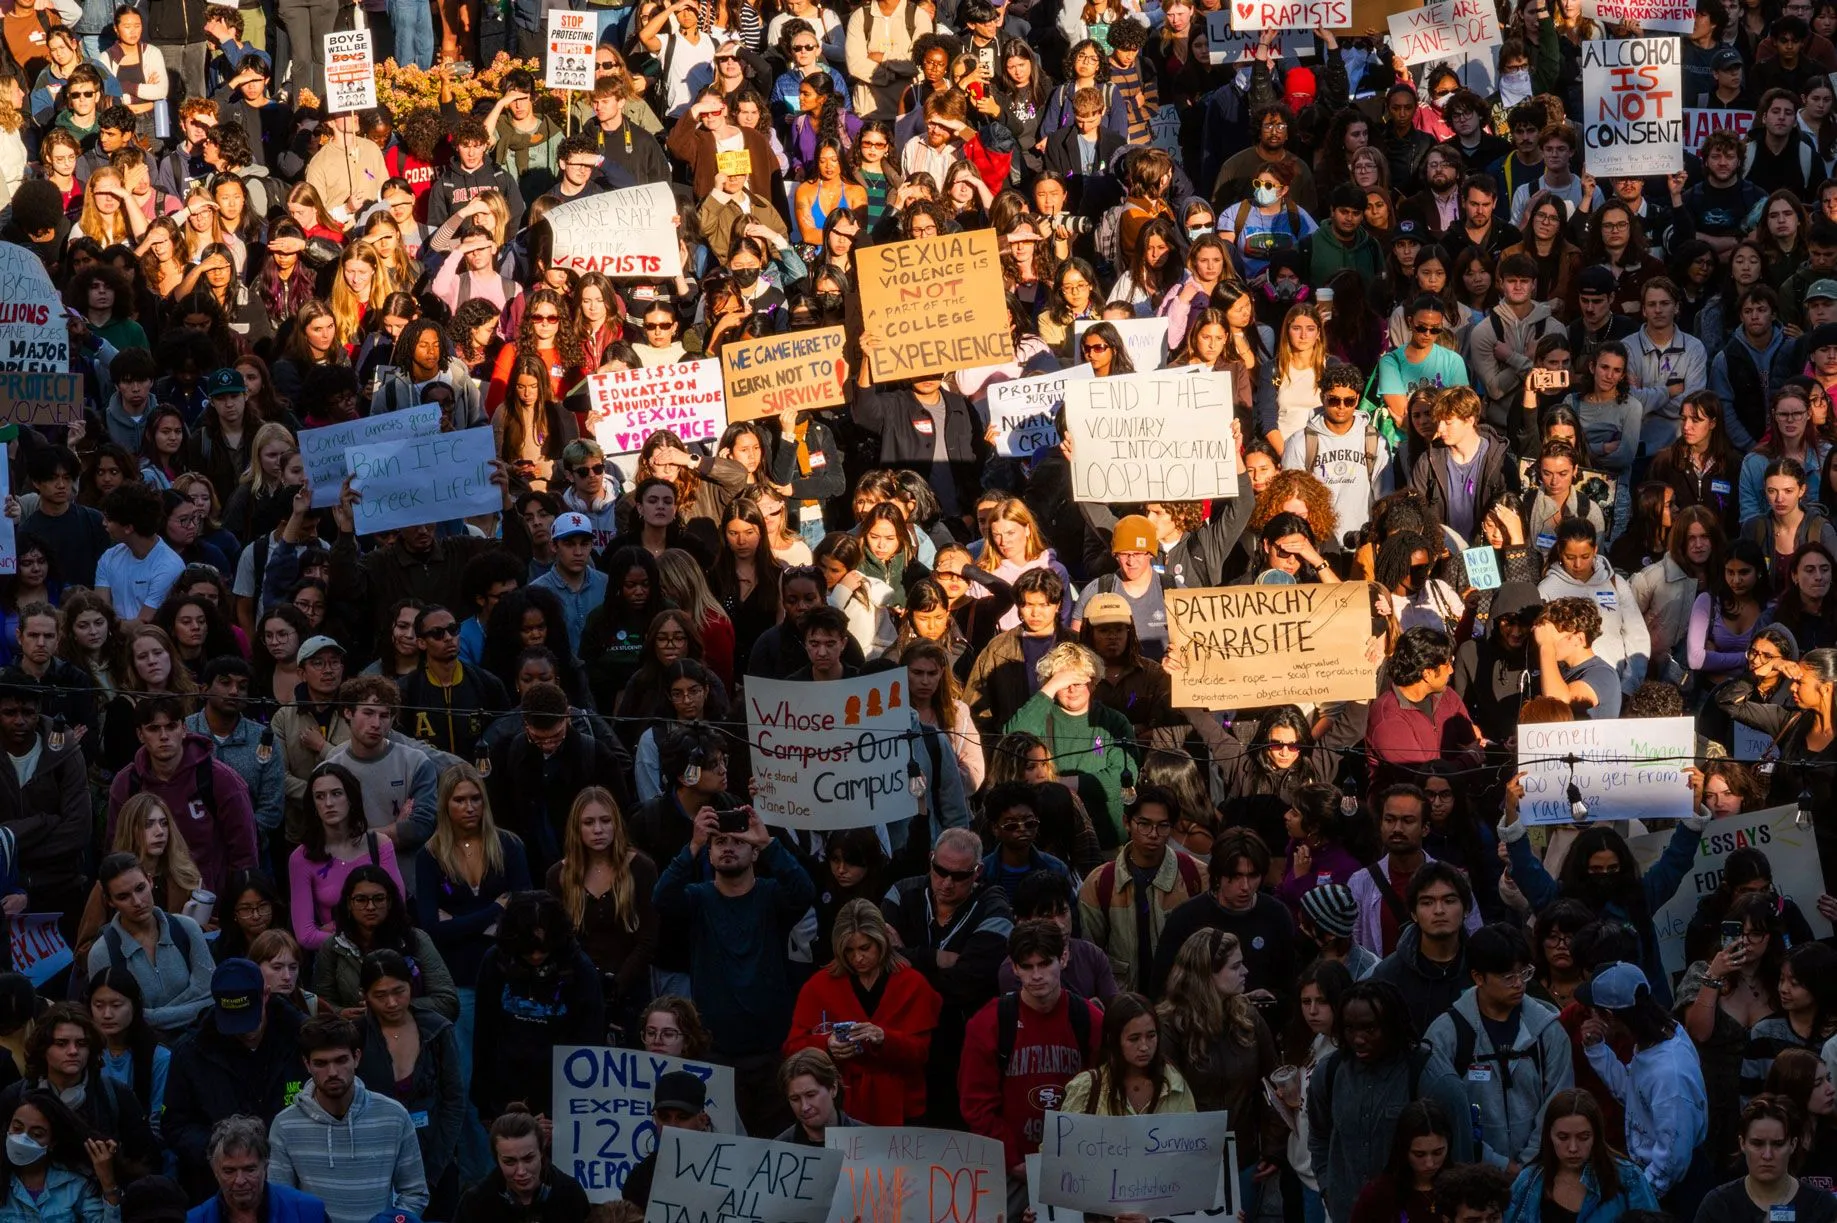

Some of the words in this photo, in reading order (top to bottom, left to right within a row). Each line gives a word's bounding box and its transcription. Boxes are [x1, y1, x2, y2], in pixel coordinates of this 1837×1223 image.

[561, 15, 584, 27] STOP
[1261, 1, 1347, 26] RAPISTS
[1407, 4, 1446, 27] WE
[1452, 0, 1483, 22] ARE
[329, 33, 364, 45] BOYS
[551, 29, 594, 40] PROTECTING
[1399, 26, 1451, 60] JANE
[1454, 14, 1493, 46] DOE
[328, 45, 353, 54] WILL
[354, 43, 368, 51] BE
[1582, 38, 1681, 68] ALCOHOL
[1610, 66, 1659, 92] IS
[1599, 91, 1673, 122] NOT
[1585, 120, 1682, 148] CONSENT
[615, 186, 655, 207] THAT
[555, 210, 609, 229] CAUSE
[571, 255, 661, 273] RAPISTS
[880, 238, 987, 273] SEXUAL
[879, 262, 965, 288] VIOLENCE
[973, 258, 989, 270] IS
[900, 279, 963, 302] NOT
[868, 309, 877, 319] A
[885, 302, 921, 318] PART
[923, 300, 938, 310] OF
[942, 296, 968, 308] THE
[9, 340, 67, 361] MAJOR
[727, 348, 752, 372] WE
[754, 341, 791, 365] CAME
[792, 336, 821, 358] HERE
[822, 333, 841, 350] TO
[592, 369, 640, 386] THE
[775, 365, 803, 387] NOT
[808, 360, 833, 377] TO
[598, 379, 697, 402] EDUCATION
[670, 390, 722, 406] INCLUDE
[998, 379, 1068, 401] PROTECT
[1088, 380, 1139, 411] END
[1148, 376, 1224, 409] THE
[626, 407, 697, 428] SEXUAL
[1085, 416, 1165, 440] VOLUNTARY
[306, 430, 356, 454] Cornell
[364, 419, 404, 437] arrests
[408, 408, 438, 431] grad
[352, 451, 401, 480] Ban
[410, 438, 468, 471] IFC
[1109, 438, 1228, 460] INTOXICATION
[1314, 449, 1367, 468] BANGKOK
[1073, 460, 1240, 499] LOOPHOLE
[359, 484, 424, 519] Greek
[1466, 549, 1489, 567] NO
[1471, 573, 1492, 587] NO
[1173, 588, 1318, 625] PATRIARCHY
[1192, 620, 1316, 661] PARASITE
[1242, 674, 1268, 685] rape
[1315, 668, 1373, 679] reproduction
[1256, 686, 1330, 700] objectification
[415, 711, 437, 737] A
[751, 697, 835, 731] Whose
[758, 730, 854, 769] Campus?
[857, 732, 902, 763] Our
[757, 766, 772, 780] We
[773, 770, 798, 784] stand
[1559, 775, 1591, 795] you
[1601, 772, 1633, 790] get
[758, 782, 777, 795] with
[813, 769, 904, 810] Campus
[759, 796, 785, 814] Jane
[787, 800, 810, 816] Doe
[1700, 824, 1771, 857] ESSAYS
[1656, 911, 1685, 938] We
[563, 1048, 668, 1092] ONLY
[1057, 1115, 1130, 1157] Protect
[887, 1135, 926, 1161] ARE
[939, 1135, 994, 1166] ALL
[675, 1138, 736, 1188] WE
[746, 1149, 821, 1201] ARE
[717, 1188, 762, 1219] ALL
